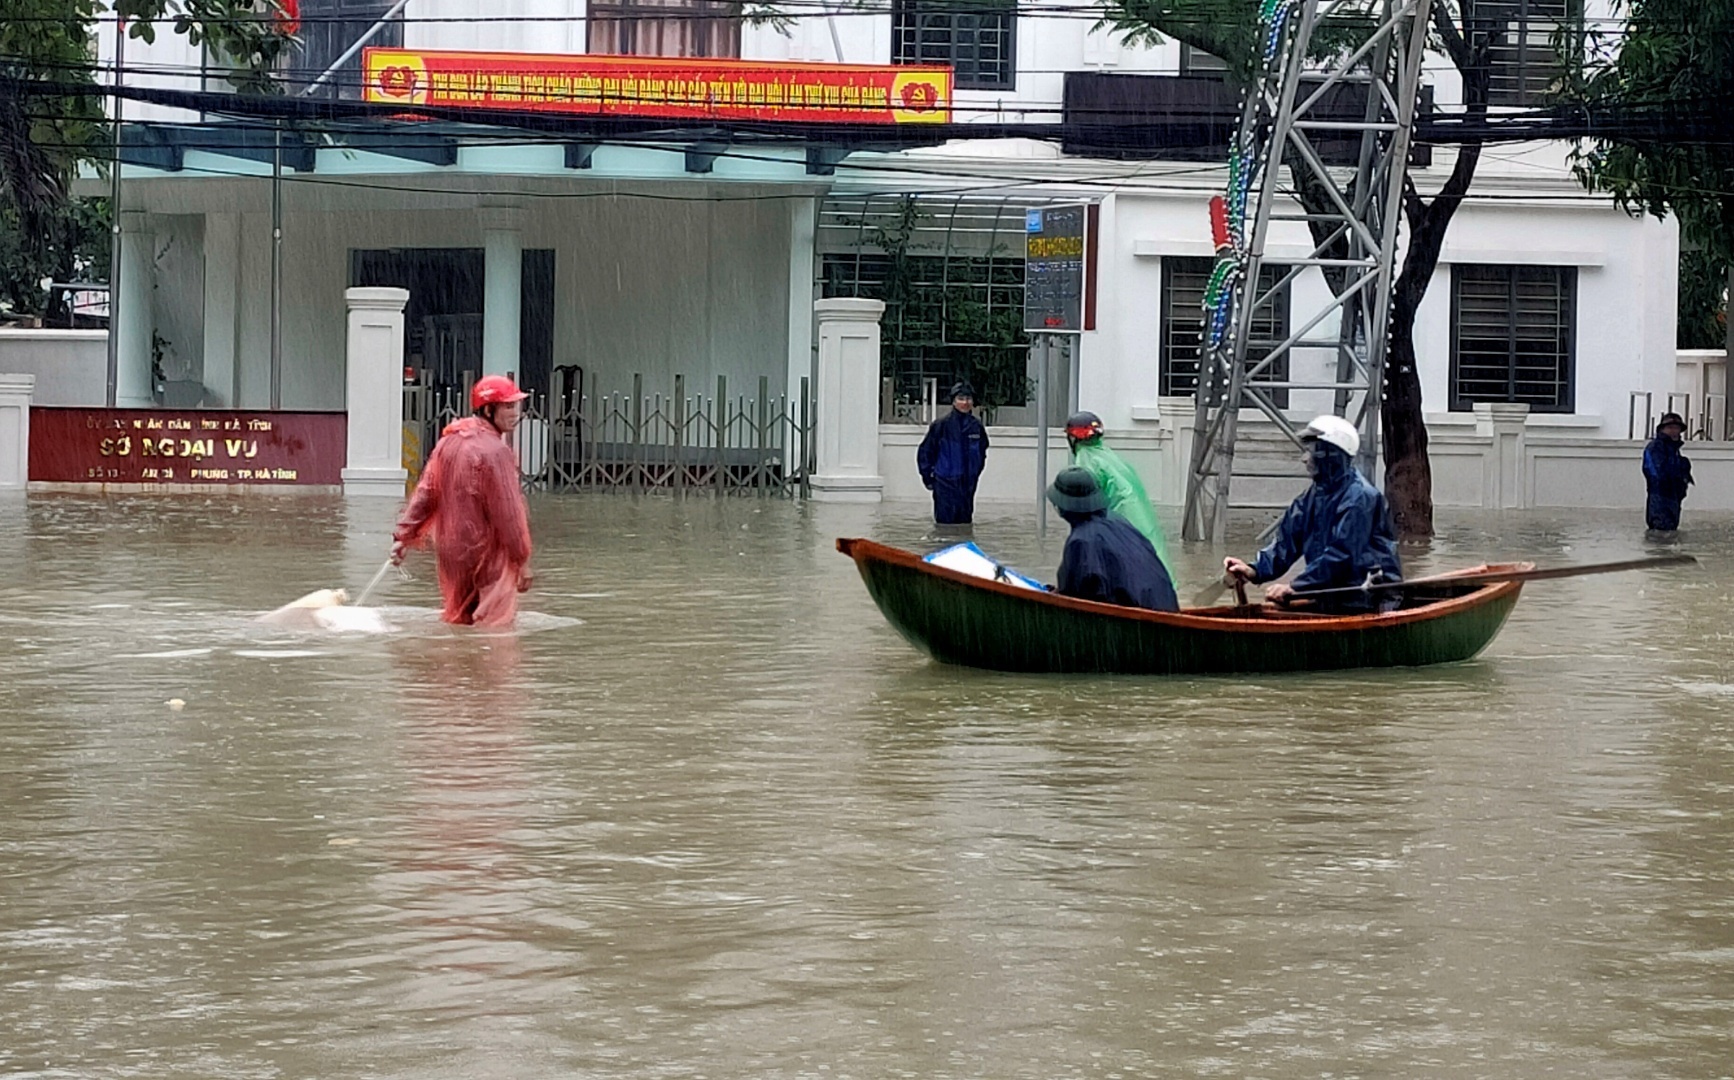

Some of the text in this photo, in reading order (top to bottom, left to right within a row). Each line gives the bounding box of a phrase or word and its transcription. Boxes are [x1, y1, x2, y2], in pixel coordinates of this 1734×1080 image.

[433, 73, 448, 100] THI
[449, 74, 468, 100] ĐUA
[470, 69, 488, 106] LẬP
[490, 70, 521, 102] THÀNH
[546, 73, 571, 103] CHÀO
[603, 78, 620, 110] ĐẠI
[622, 72, 638, 110] HỘI
[667, 74, 686, 106] CÁC
[748, 81, 765, 115] ĐẠI
[766, 77, 782, 115] HỘI
[862, 78, 887, 112] ĐẢNG
[133, 418, 163, 430] NÂN
[100, 431, 257, 462] SỞ NGOẠI VỤ
